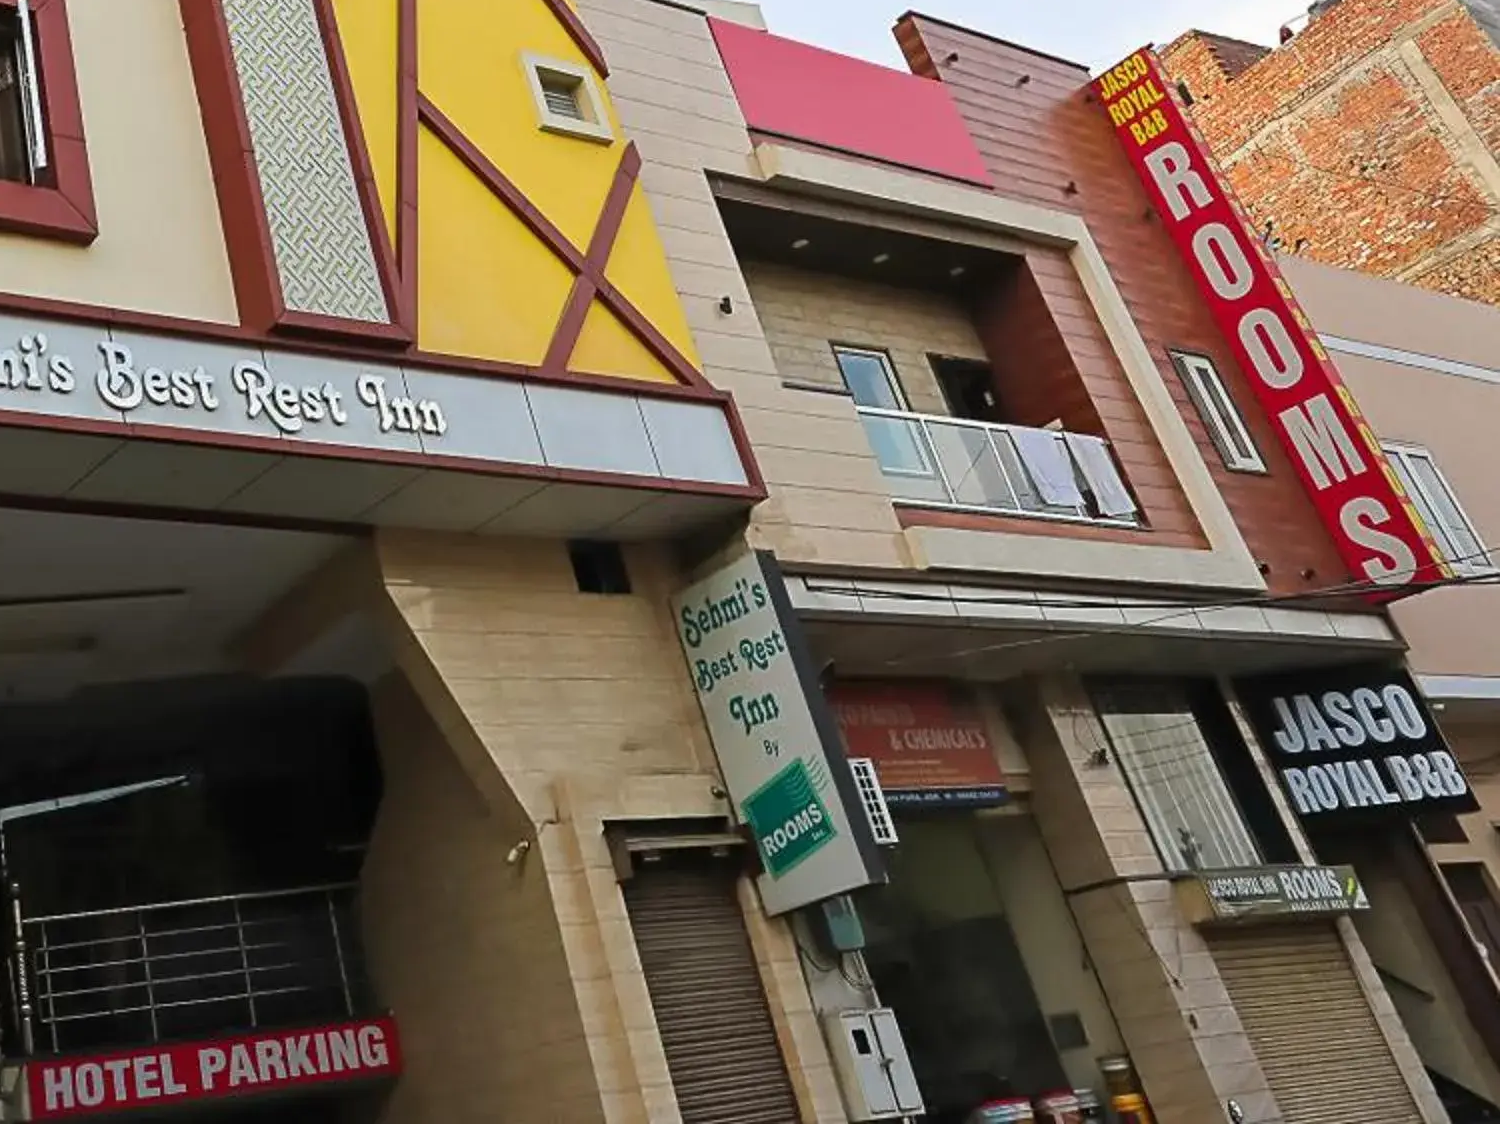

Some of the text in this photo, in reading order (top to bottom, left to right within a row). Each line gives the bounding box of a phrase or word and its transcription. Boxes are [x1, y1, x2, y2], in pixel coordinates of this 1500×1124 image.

[1100, 53, 1148, 100] JASCO
[1107, 79, 1165, 126] ROYAL
[1129, 108, 1169, 146] B&B
[97, 342, 220, 410] Best
[232, 359, 348, 432] Rest
[356, 373, 448, 435] Inn
[1144, 141, 1417, 586] ROOMS
[681, 577, 766, 649] Sehmi's
[696, 629, 785, 692] Best Rest
[729, 691, 780, 735] Inn
[1272, 683, 1427, 754] JASCO
[763, 739, 780, 757] By
[1283, 749, 1468, 814] ROYAL B&B
[762, 803, 823, 856] ROOMS
[1279, 869, 1342, 899] ROOMS
[43, 1025, 390, 1111] HOTEL PARKING
